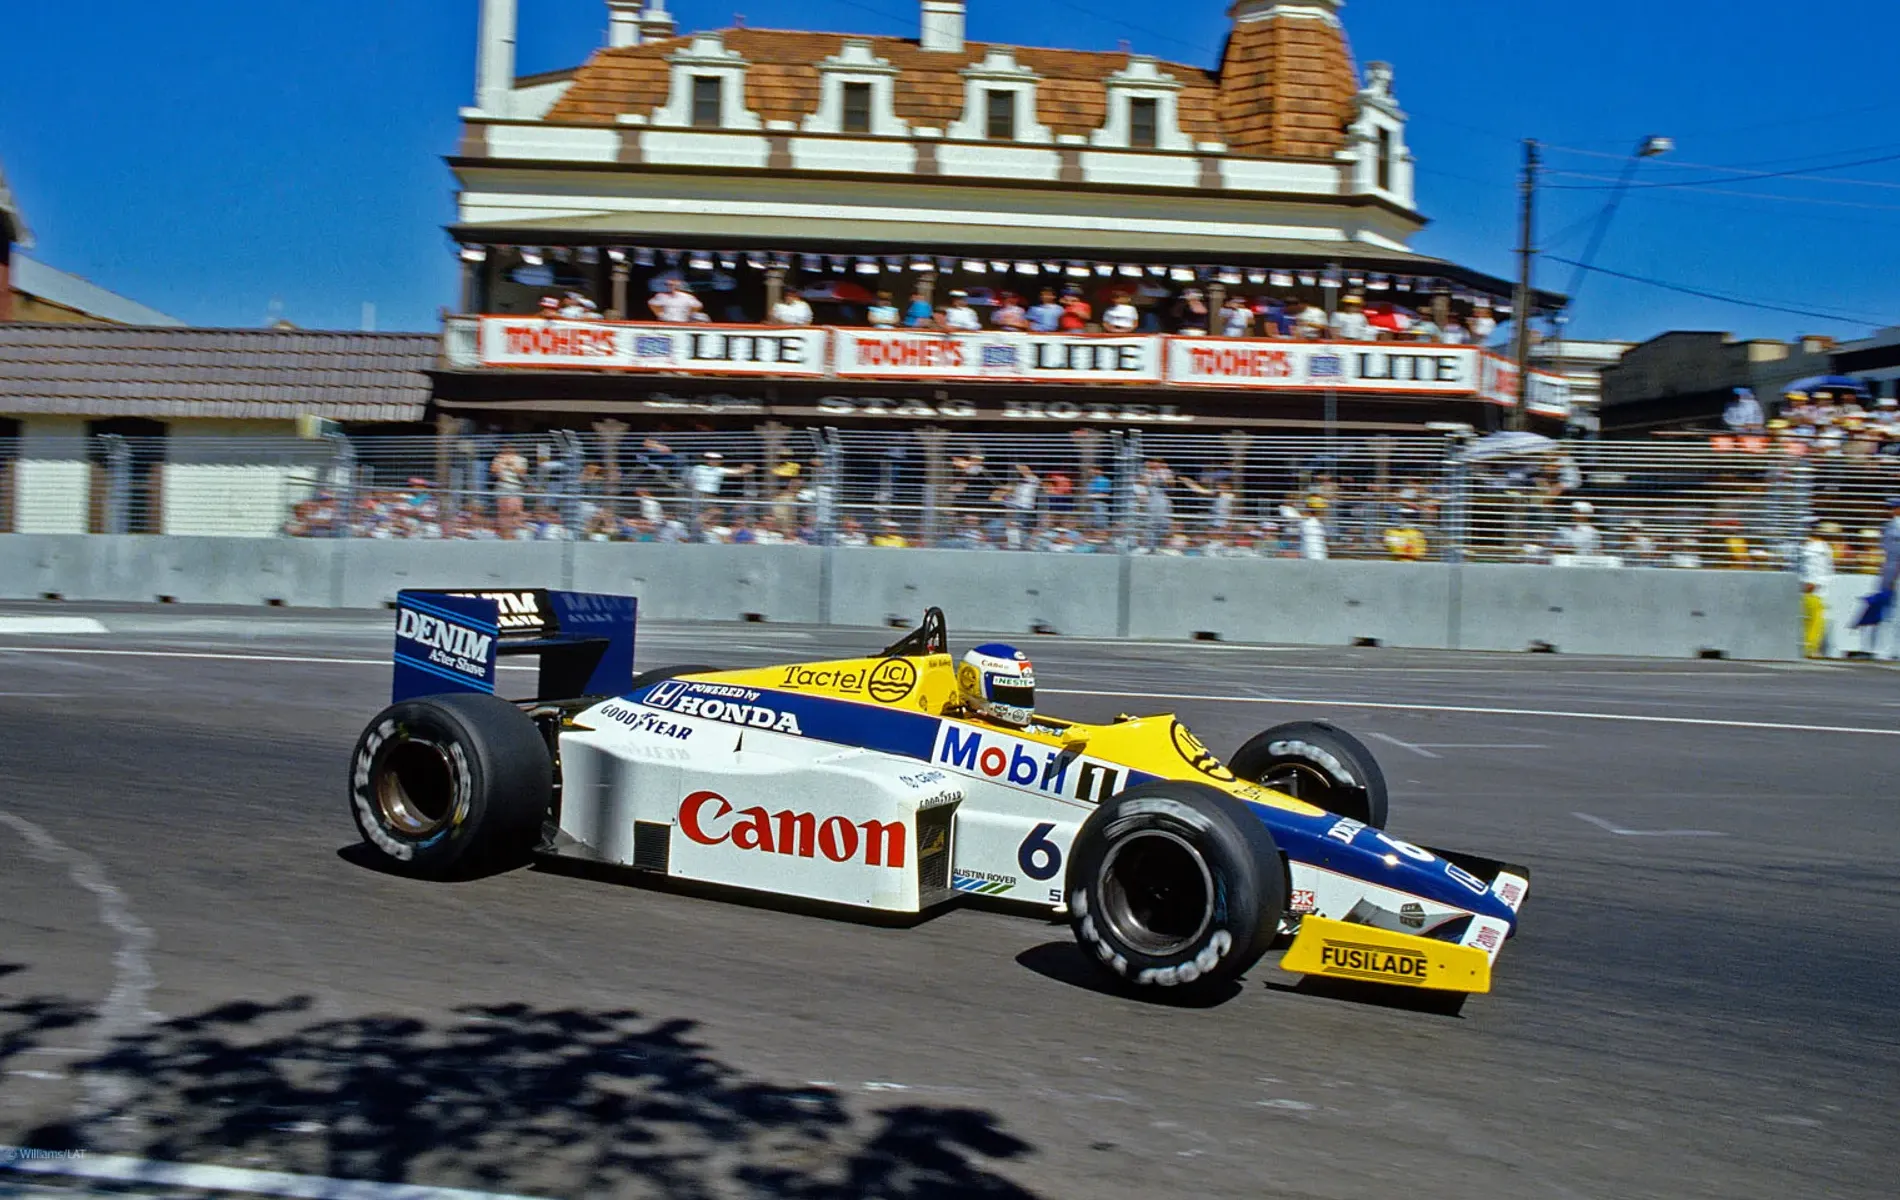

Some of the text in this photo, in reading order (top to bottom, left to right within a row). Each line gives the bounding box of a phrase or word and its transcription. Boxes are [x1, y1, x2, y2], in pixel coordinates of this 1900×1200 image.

[690, 333, 807, 364] LITE
[1032, 342, 1145, 371] LITE
[1355, 352, 1464, 382] LITE
[1000, 401, 1196, 422] HOTEL
[396, 608, 493, 664] DENIM
[428, 648, 487, 678] After Shave
[882, 665, 908, 681] ICI
[687, 683, 762, 702] POWERED by
[780, 665, 866, 692] Tactel
[673, 695, 803, 736] HONDA
[940, 726, 1070, 796] Mobil
[1088, 767, 1106, 803] 1
[679, 790, 907, 869] Canon
[1018, 822, 1062, 881] 6
[953, 867, 1017, 885] AUSTIN ROVER
[1321, 946, 1429, 978] FUSILADE
